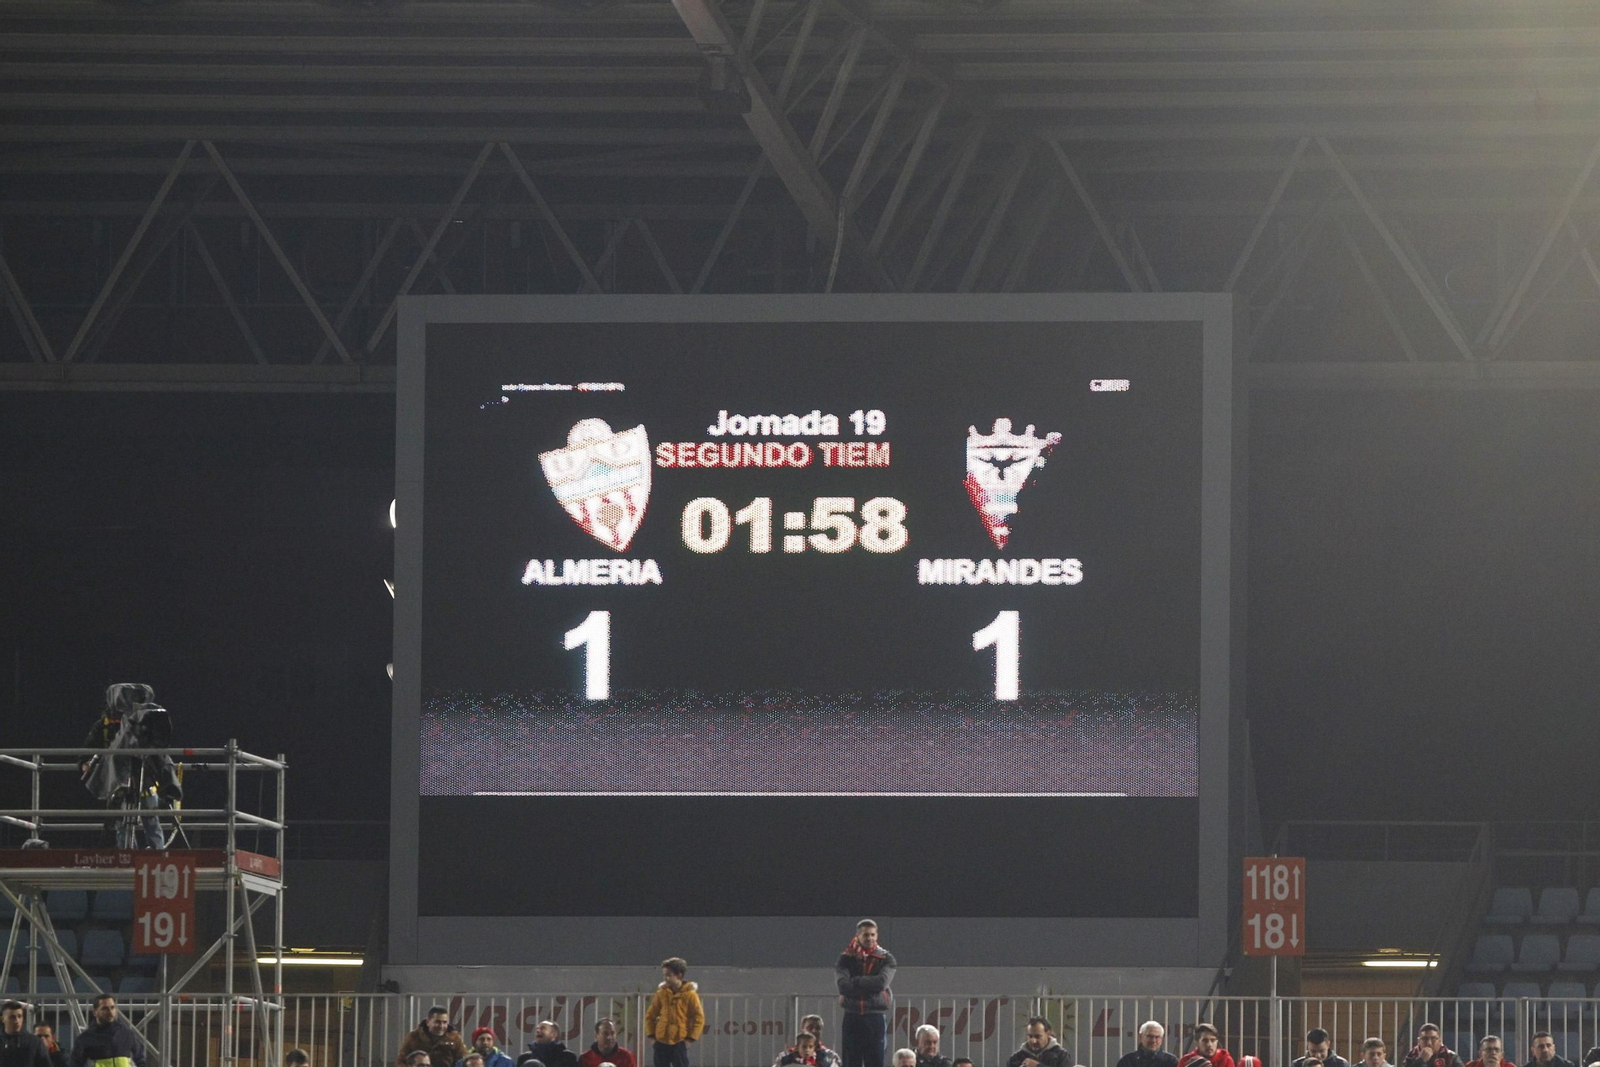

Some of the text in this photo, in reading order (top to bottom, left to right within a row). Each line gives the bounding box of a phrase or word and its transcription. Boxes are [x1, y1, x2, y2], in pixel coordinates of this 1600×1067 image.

[707, 409, 887, 436] Jornada 19
[656, 441, 890, 468] SEGUNDO TIEM
[681, 497, 909, 554] 01:58
[521, 558, 663, 586] ALMERIA
[918, 558, 1083, 586] MIRANDES
[564, 610, 611, 700] 1
[972, 610, 1020, 700] 1
[138, 863, 179, 900] 119
[1246, 864, 1290, 901] 118
[138, 911, 174, 948] 19
[1247, 912, 1285, 950] 18
